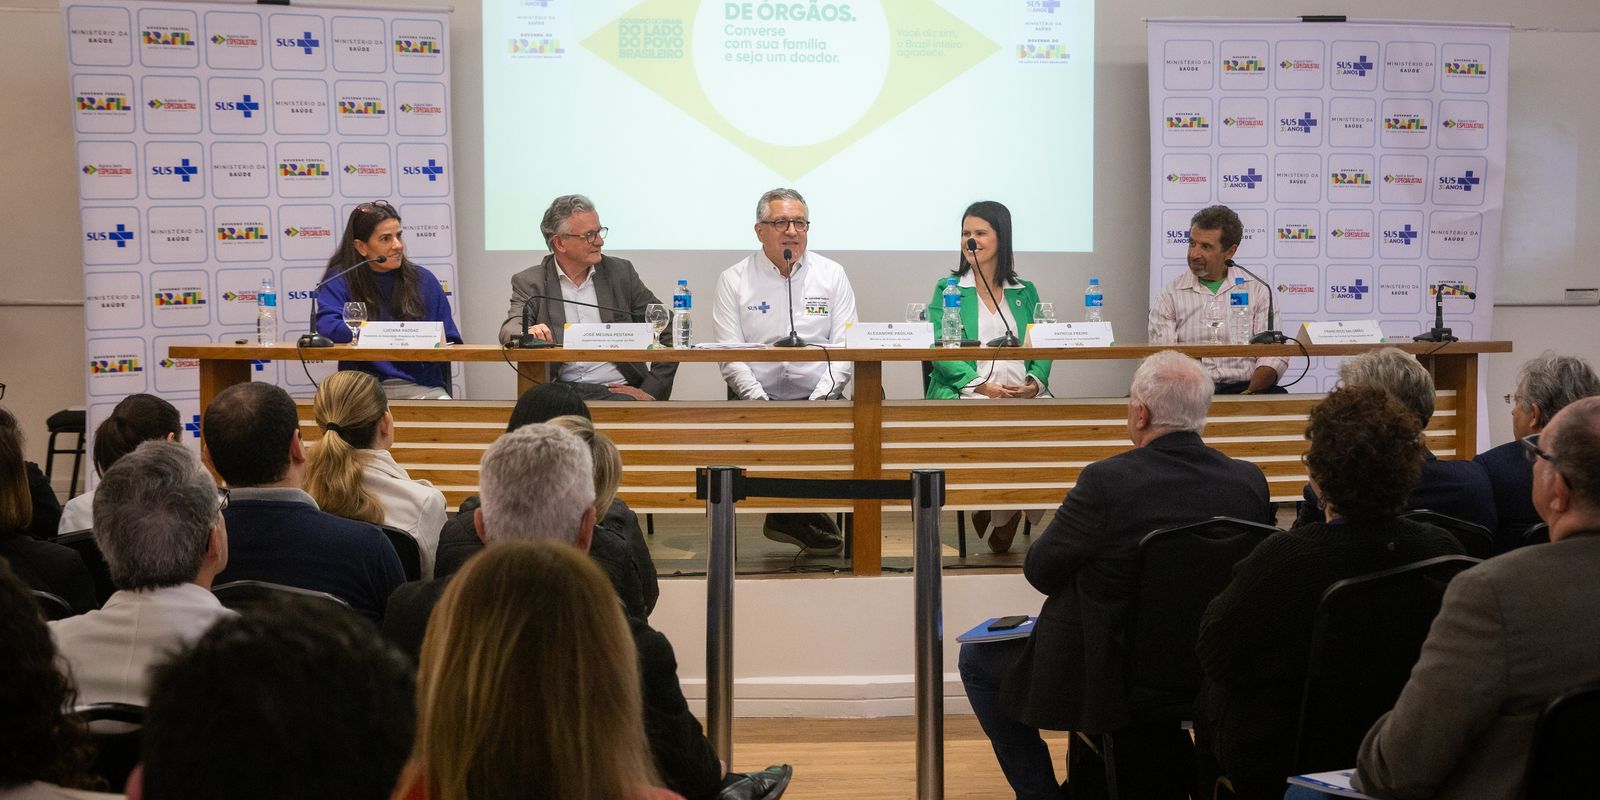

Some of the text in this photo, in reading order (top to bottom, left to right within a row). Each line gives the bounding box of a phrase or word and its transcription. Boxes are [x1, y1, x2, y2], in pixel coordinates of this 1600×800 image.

[725, 0, 856, 22] DE ÓRGÃOS.
[619, 25, 684, 36] DO LADO
[724, 24, 786, 36] Converse
[142, 31, 195, 46] BRASIL
[276, 38, 296, 47] SUS
[619, 36, 684, 48] DO POVO
[725, 38, 827, 50] com sua família
[396, 40, 440, 54] BRASIL
[619, 48, 684, 58] BRASILEIRO
[725, 51, 840, 64] e seja um doador.
[1224, 60, 1266, 71] BRASIL
[1444, 63, 1486, 75] BRASIL
[76, 97, 132, 110] BRASIL
[216, 102, 235, 110] SUS
[338, 101, 386, 114] BRASIL
[1166, 116, 1208, 128] BRASIL
[1384, 118, 1428, 130] BRASIL
[152, 166, 172, 175] SUS
[280, 163, 330, 176] BRASIL
[404, 166, 421, 175] SUS
[1224, 174, 1240, 182] SUS
[1332, 173, 1372, 184] BRASIL
[1440, 176, 1456, 184] SUS
[86, 232, 108, 241] SUS
[217, 227, 269, 240] BRASIL
[1166, 230, 1182, 238] SUS
[1278, 228, 1316, 240] BRASIL
[154, 292, 206, 306] BRASIL
[288, 290, 308, 300] SUS
[90, 359, 143, 374] BRASIL
